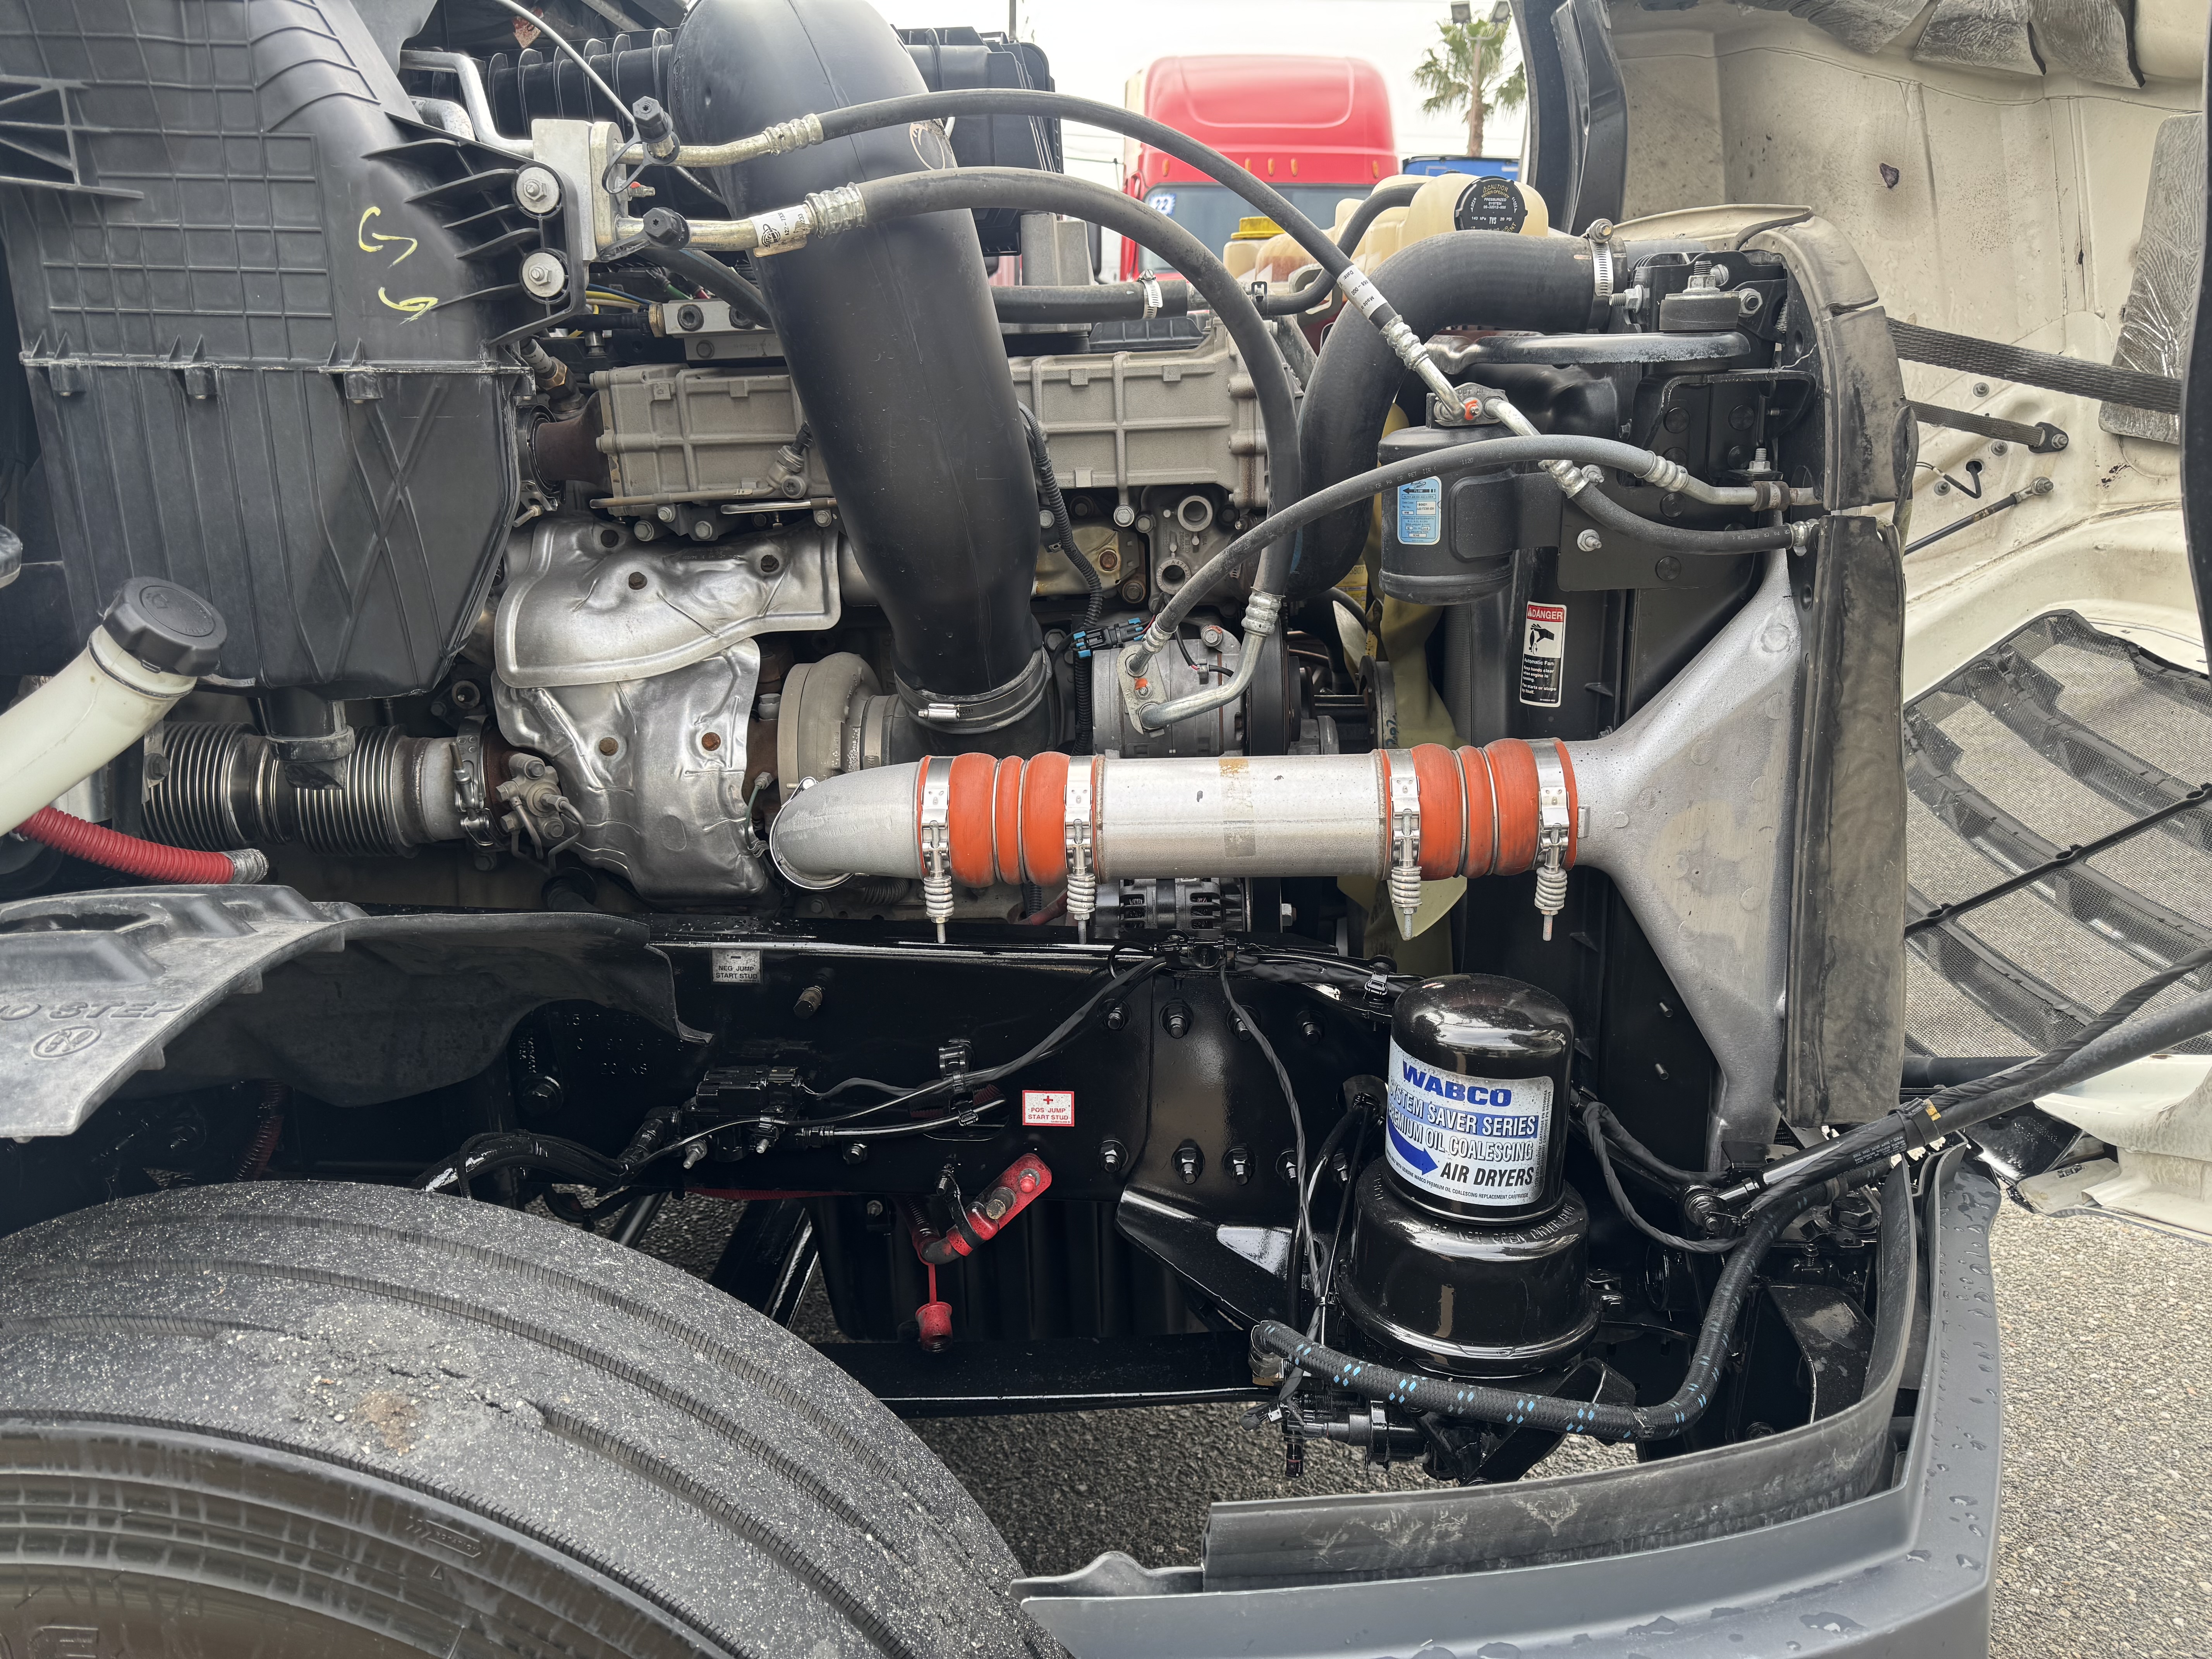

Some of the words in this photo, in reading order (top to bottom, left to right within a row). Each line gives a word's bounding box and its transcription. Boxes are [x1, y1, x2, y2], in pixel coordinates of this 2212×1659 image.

[1487, 184, 1509, 192] CAUTION
[1489, 216, 1497, 225] TVS
[1532, 610, 1563, 620] DANGER
[49, 1001, 186, 1020] STEP
[1402, 1060, 1512, 1107] WABCO
[1389, 1075, 1424, 1120] SYSTEM
[1427, 1101, 1478, 1136] SAVER
[1481, 1115, 1537, 1136] SERIES
[1388, 1100, 1424, 1145] PREMIUM
[1425, 1128, 1446, 1153] OIL
[1448, 1136, 1534, 1162] COALESCING
[1414, 1174, 1427, 1184] WABCO
[1426, 1180, 1445, 1190] PREMIUM
[1452, 1188, 1478, 1198] COALESCING
[1440, 1162, 1470, 1184] AIR
[1473, 1167, 1535, 1188] DRYERS
[1429, 1223, 1449, 1235] DO
[1456, 1231, 1482, 1242] NOT
[1492, 1232, 1527, 1244] OPEN
